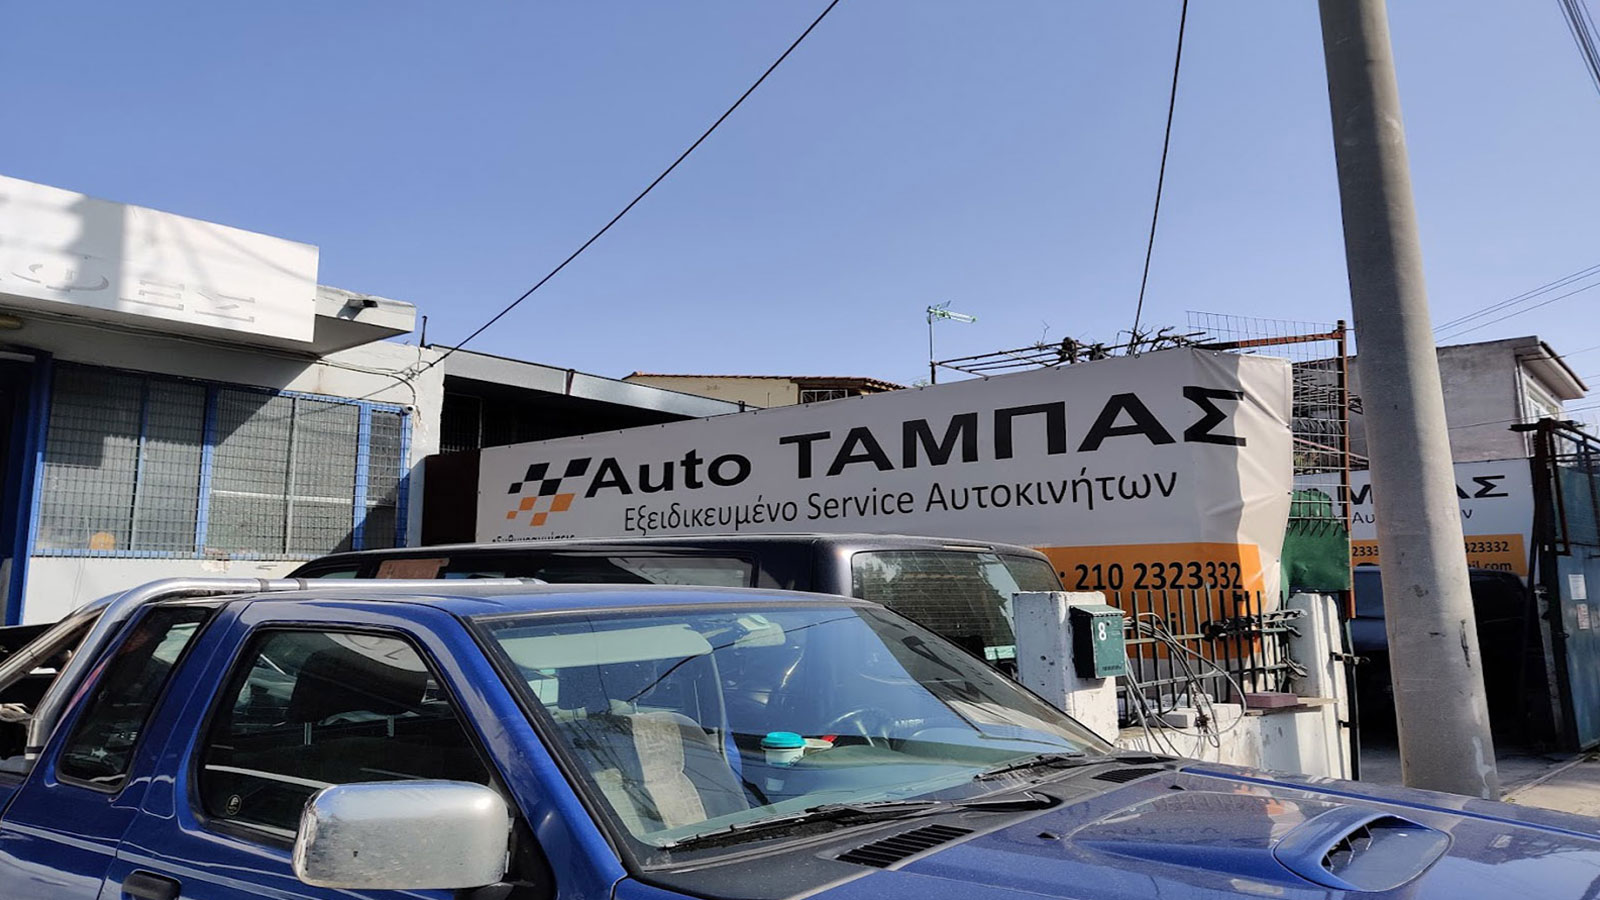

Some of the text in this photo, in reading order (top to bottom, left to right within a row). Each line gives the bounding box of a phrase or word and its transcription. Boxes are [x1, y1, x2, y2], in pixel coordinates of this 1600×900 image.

[584, 385, 1247, 498] Auto ΤΑΜΠΑΣ
[624, 466, 1178, 536] Εξειδικευμένο Service Αυτοκινήτων
[1075, 561, 1243, 590] 210 2323332
[1098, 621, 1107, 641] 8
